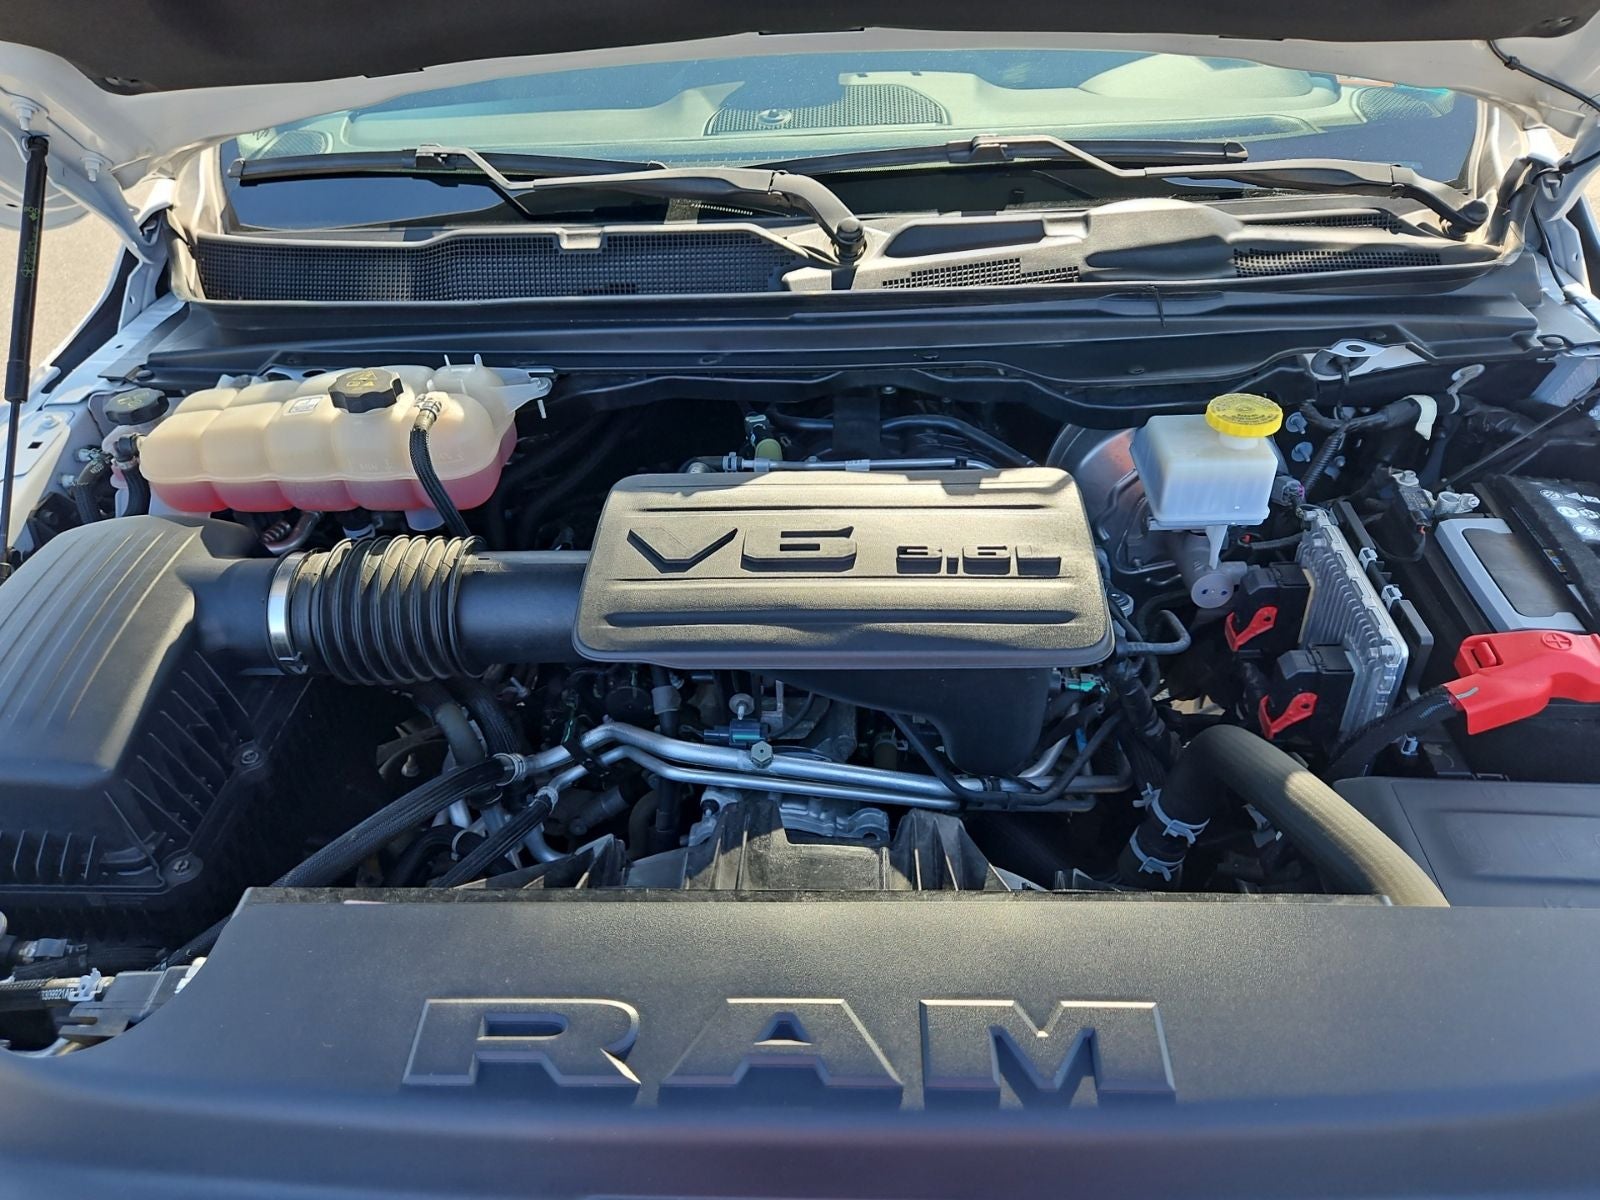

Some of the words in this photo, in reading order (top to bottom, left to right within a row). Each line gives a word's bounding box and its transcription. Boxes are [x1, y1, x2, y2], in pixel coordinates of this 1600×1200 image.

[626, 526, 858, 574] V6
[896, 544, 1062, 575] 3.6L
[402, 997, 1176, 1104] RAM
